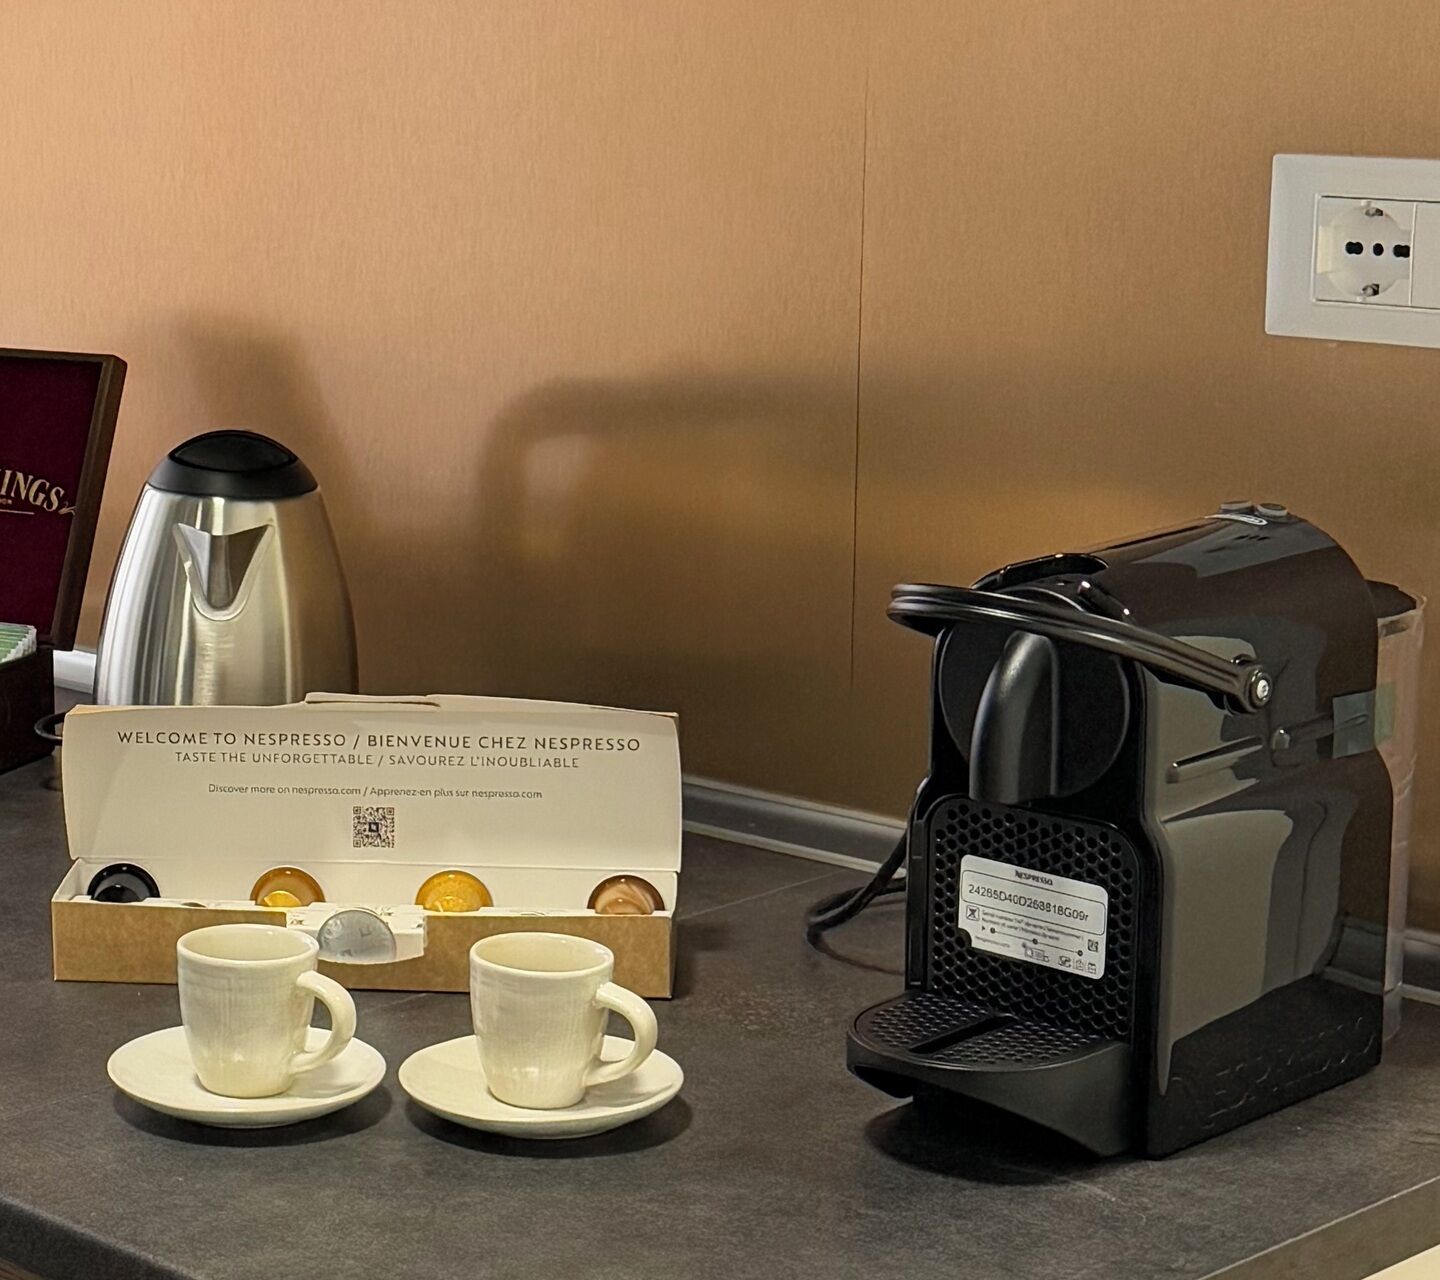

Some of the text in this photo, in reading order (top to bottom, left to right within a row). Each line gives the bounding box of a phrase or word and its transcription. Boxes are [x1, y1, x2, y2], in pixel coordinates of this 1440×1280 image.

[117, 731, 208, 745] WELCOME
[213, 732, 237, 745] TO
[244, 733, 346, 746] NESPRESSO
[367, 734, 472, 749] BIENVENUE
[478, 736, 527, 750] CHEZ
[534, 737, 641, 751] NESPRESSO
[175, 751, 217, 763] TASTE
[220, 752, 246, 763] THE
[252, 752, 374, 765] UNFORGETTABLE
[388, 754, 465, 767] SAVOUREZ
[470, 756, 580, 768] L'INOUBLIABLE
[208, 783, 249, 794] Discover
[250, 786, 276, 794] more
[277, 786, 290, 794] on
[291, 786, 361, 796] nespresso.com
[369, 787, 432, 797] Apprenez-en
[434, 788, 454, 798] plus
[455, 789, 470, 797] sur
[471, 790, 543, 799] nespresso.com
